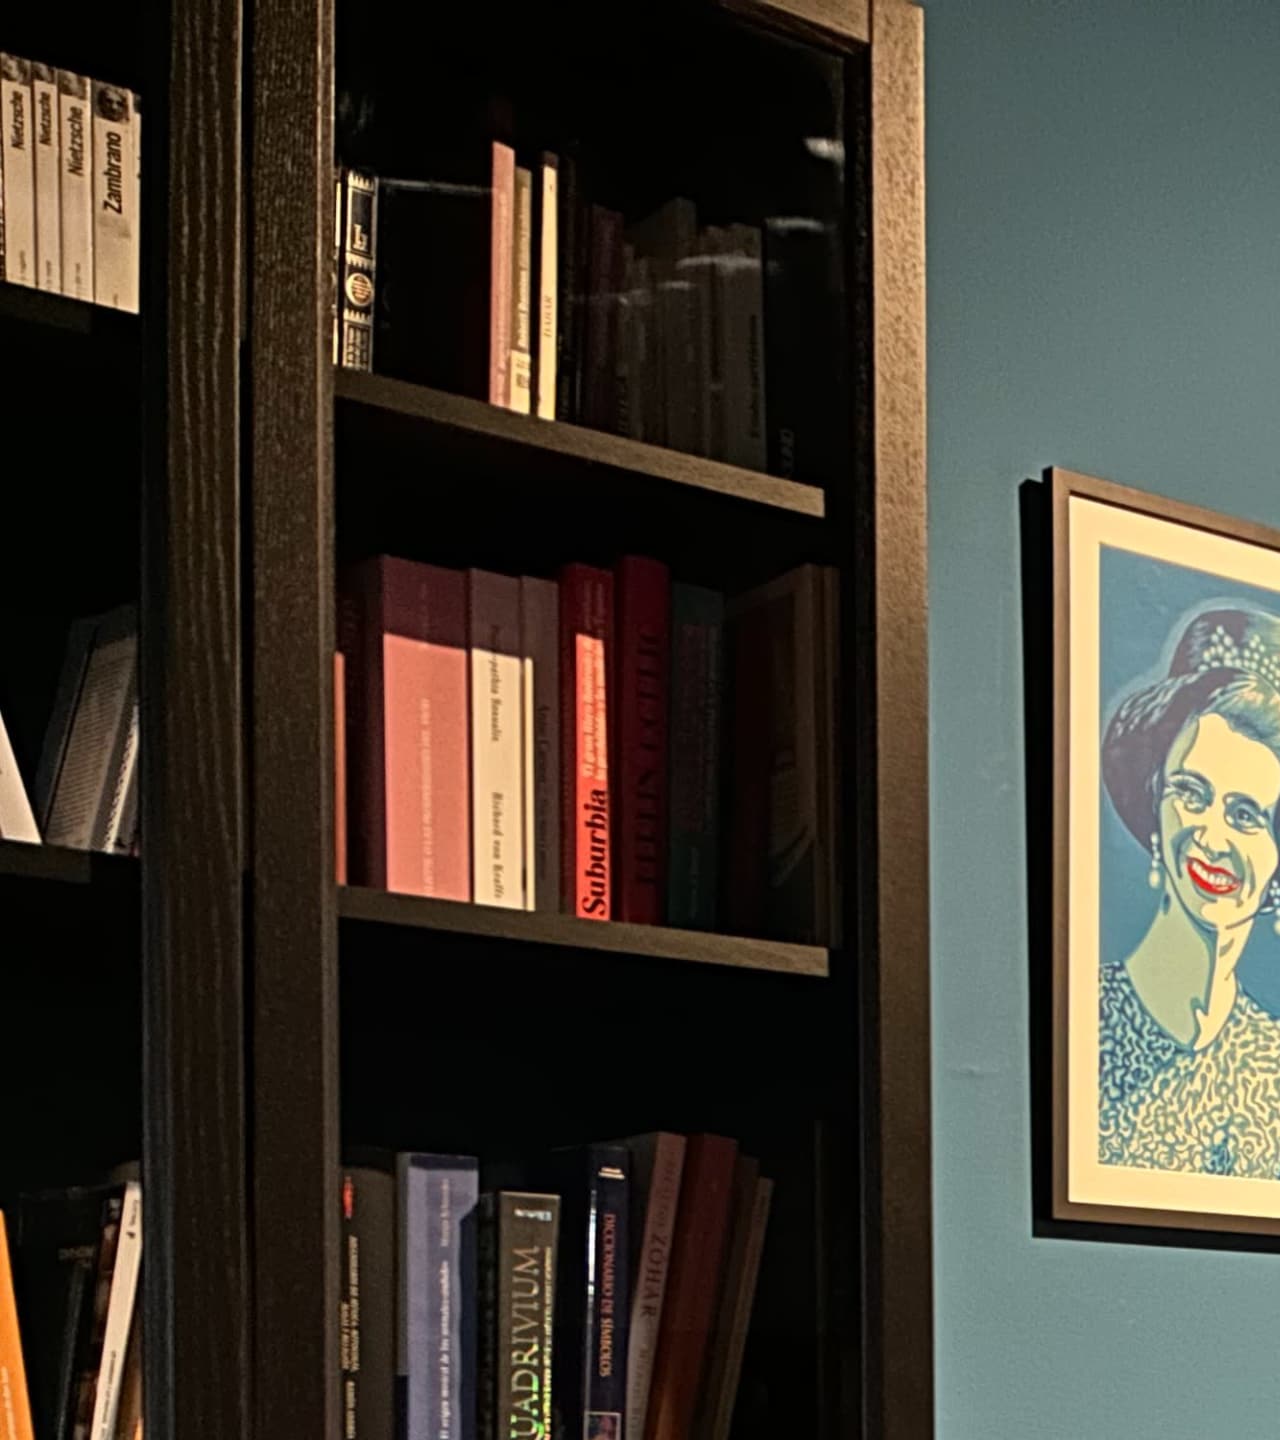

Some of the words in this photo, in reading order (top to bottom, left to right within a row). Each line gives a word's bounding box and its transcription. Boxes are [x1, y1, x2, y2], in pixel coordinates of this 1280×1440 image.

[10, 90, 25, 151] Nietzsche
[38, 91, 52, 146] Nietzsche
[66, 106, 84, 177] Nietzsche
[102, 131, 122, 215] Zambrano
[581, 788, 608, 917] Suburbia
[601, 1212, 617, 1295] DICCIONARIO
[600, 1298, 615, 1313] DE
[599, 1316, 615, 1378] SÍMBOLOS
